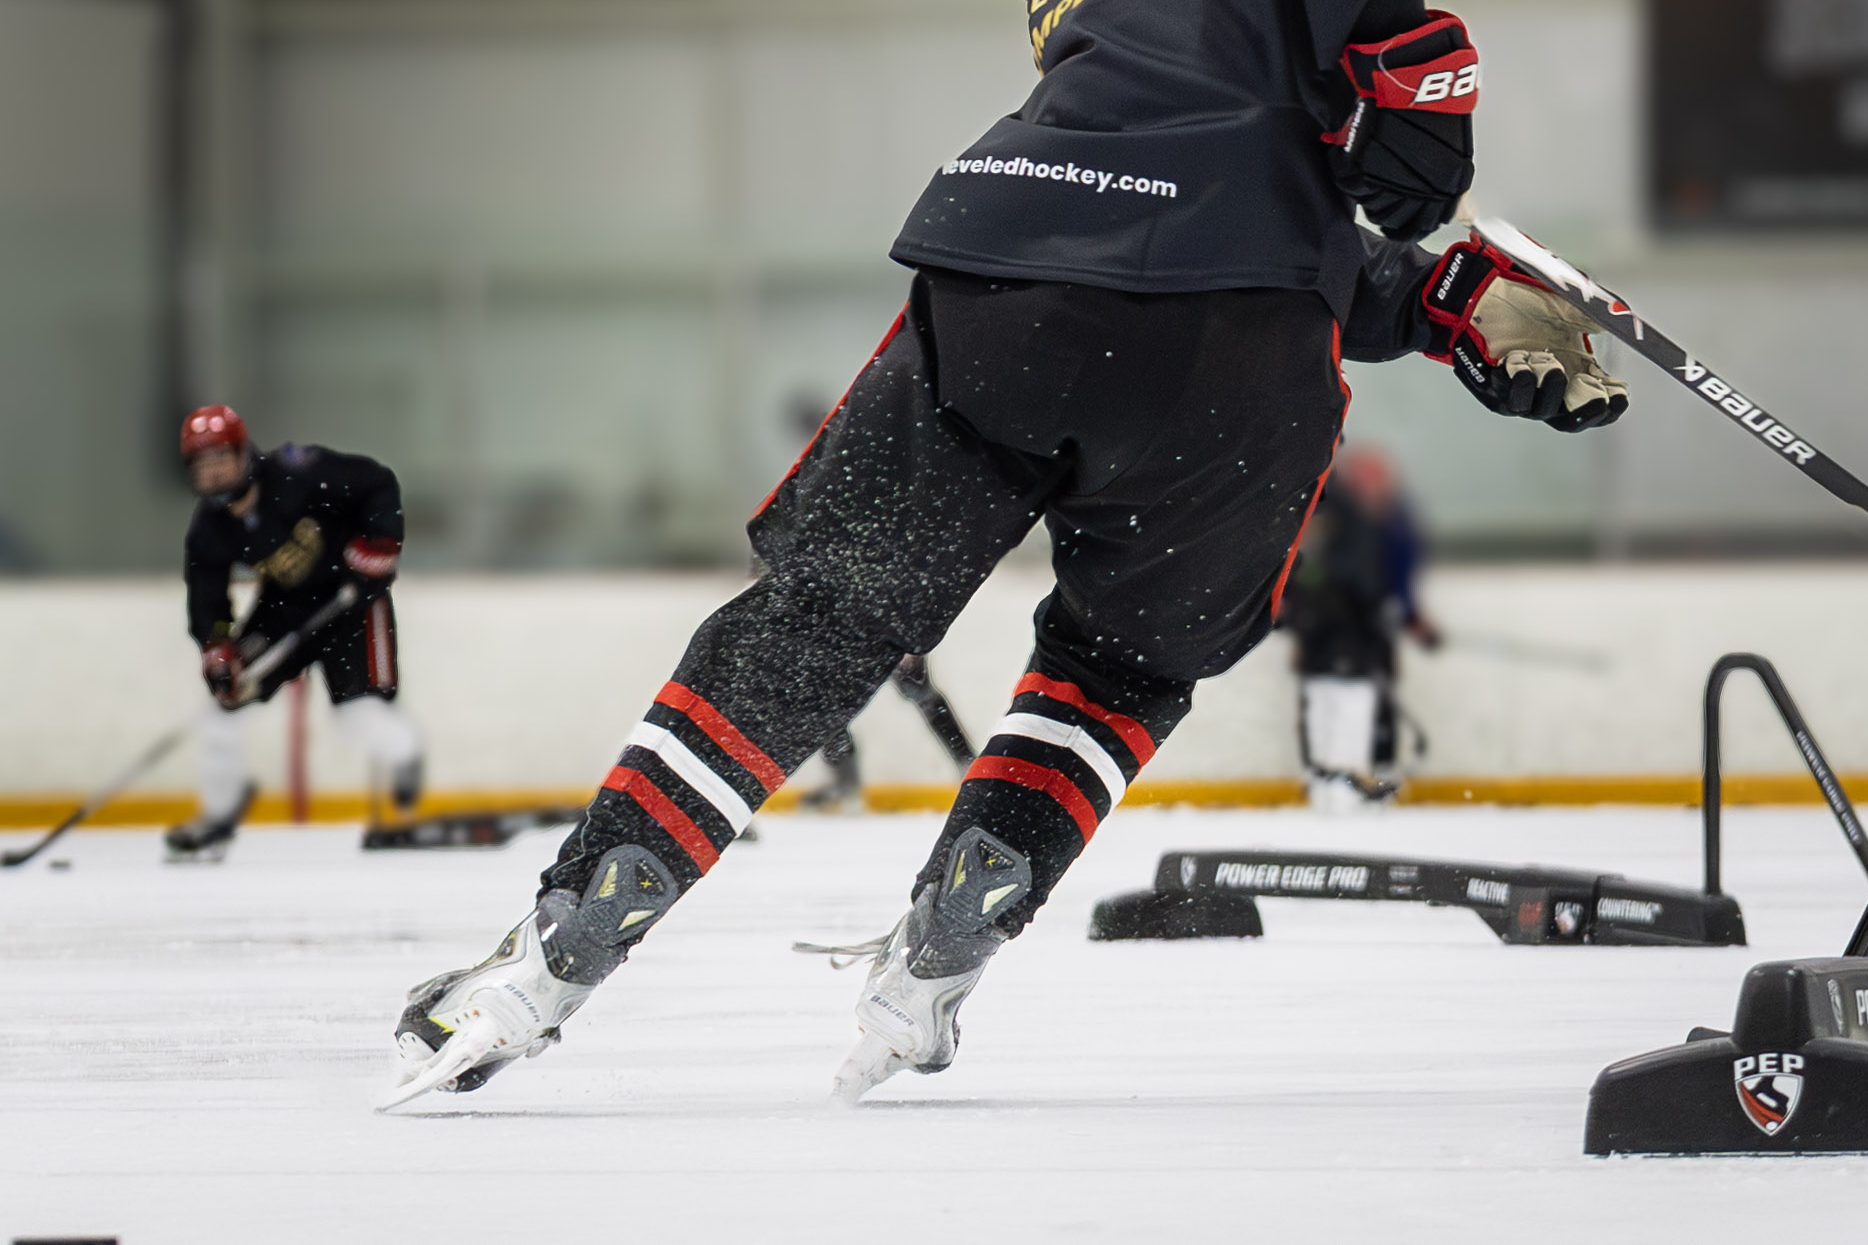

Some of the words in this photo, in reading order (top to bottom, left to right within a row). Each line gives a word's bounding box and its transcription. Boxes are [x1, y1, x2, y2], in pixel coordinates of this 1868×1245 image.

[1414, 64, 1479, 103] BA
[1437, 252, 1464, 300] BAUER
[1697, 377, 1816, 465] BAUER
[1215, 862, 1281, 889] POWER
[1280, 864, 1328, 891] EDGE
[1327, 865, 1370, 892] PRO
[871, 994, 915, 1027] BAUER
[1734, 1052, 1805, 1081] PEP
